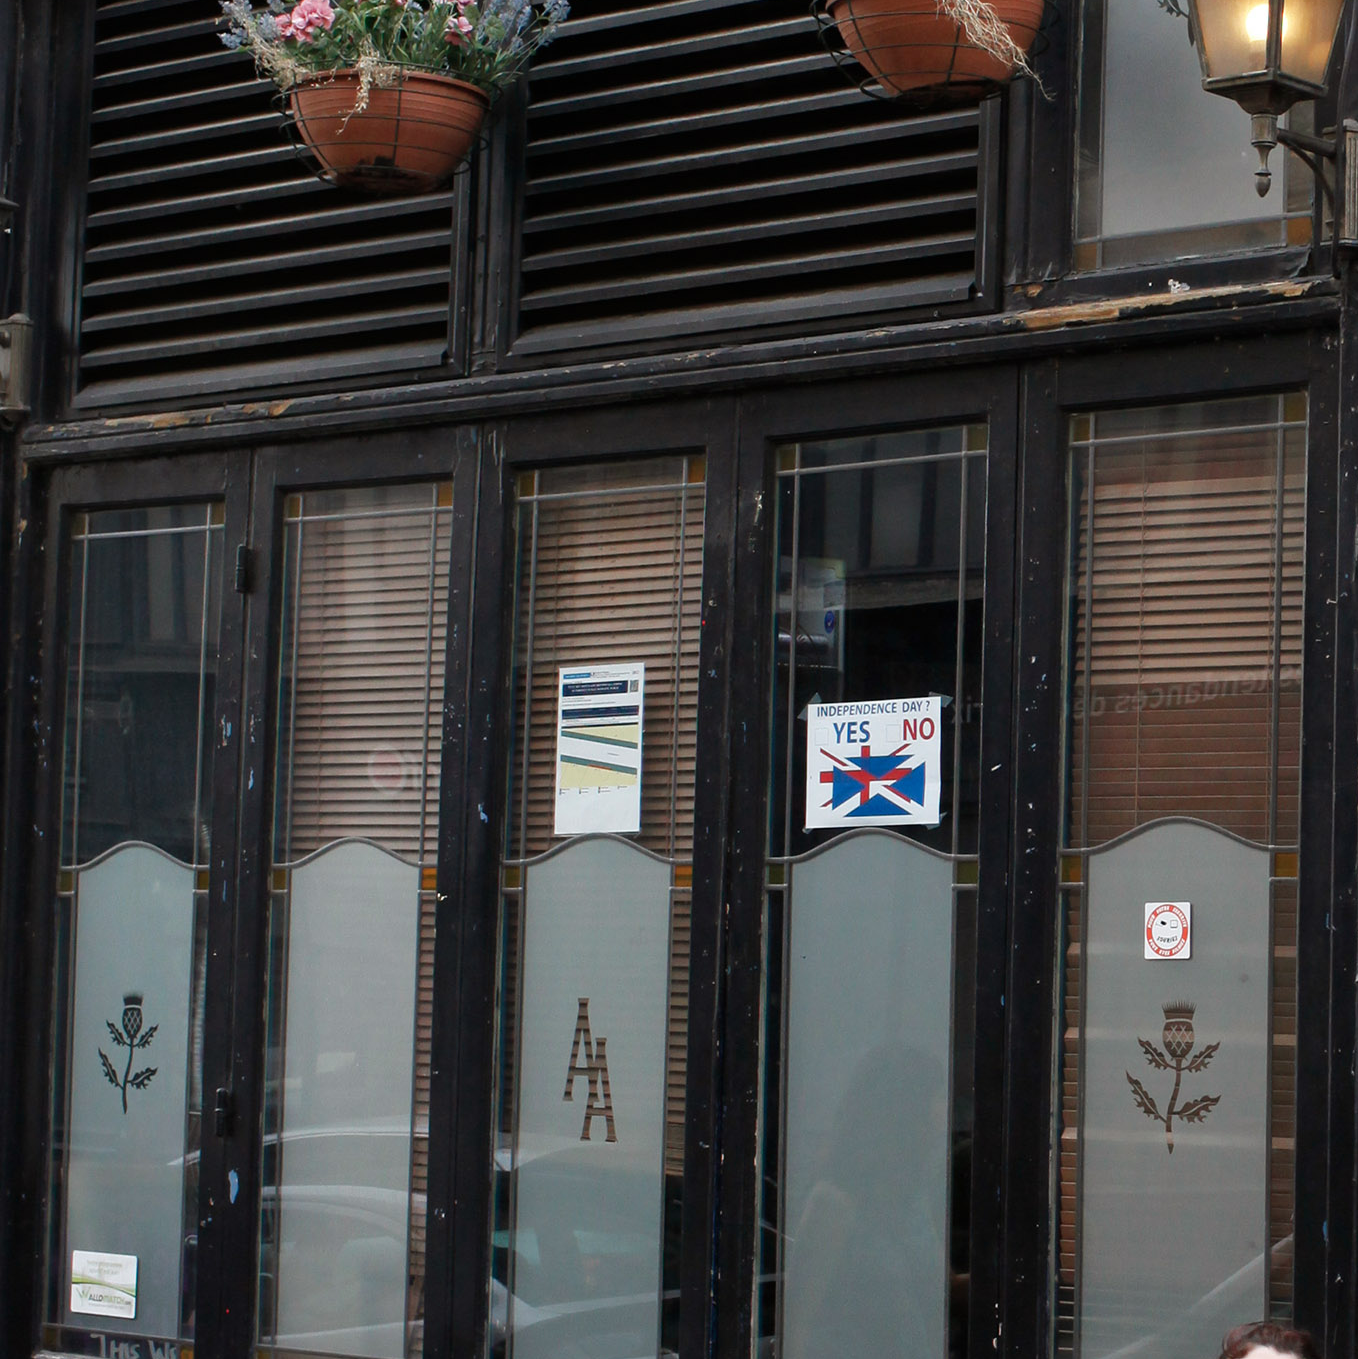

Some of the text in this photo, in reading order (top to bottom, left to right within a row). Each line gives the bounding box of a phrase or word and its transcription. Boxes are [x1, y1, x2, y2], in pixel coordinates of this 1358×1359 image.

[817, 702, 898, 718] INDEPENDENCE
[902, 700, 924, 713] DAY
[833, 717, 935, 744] YES NO
